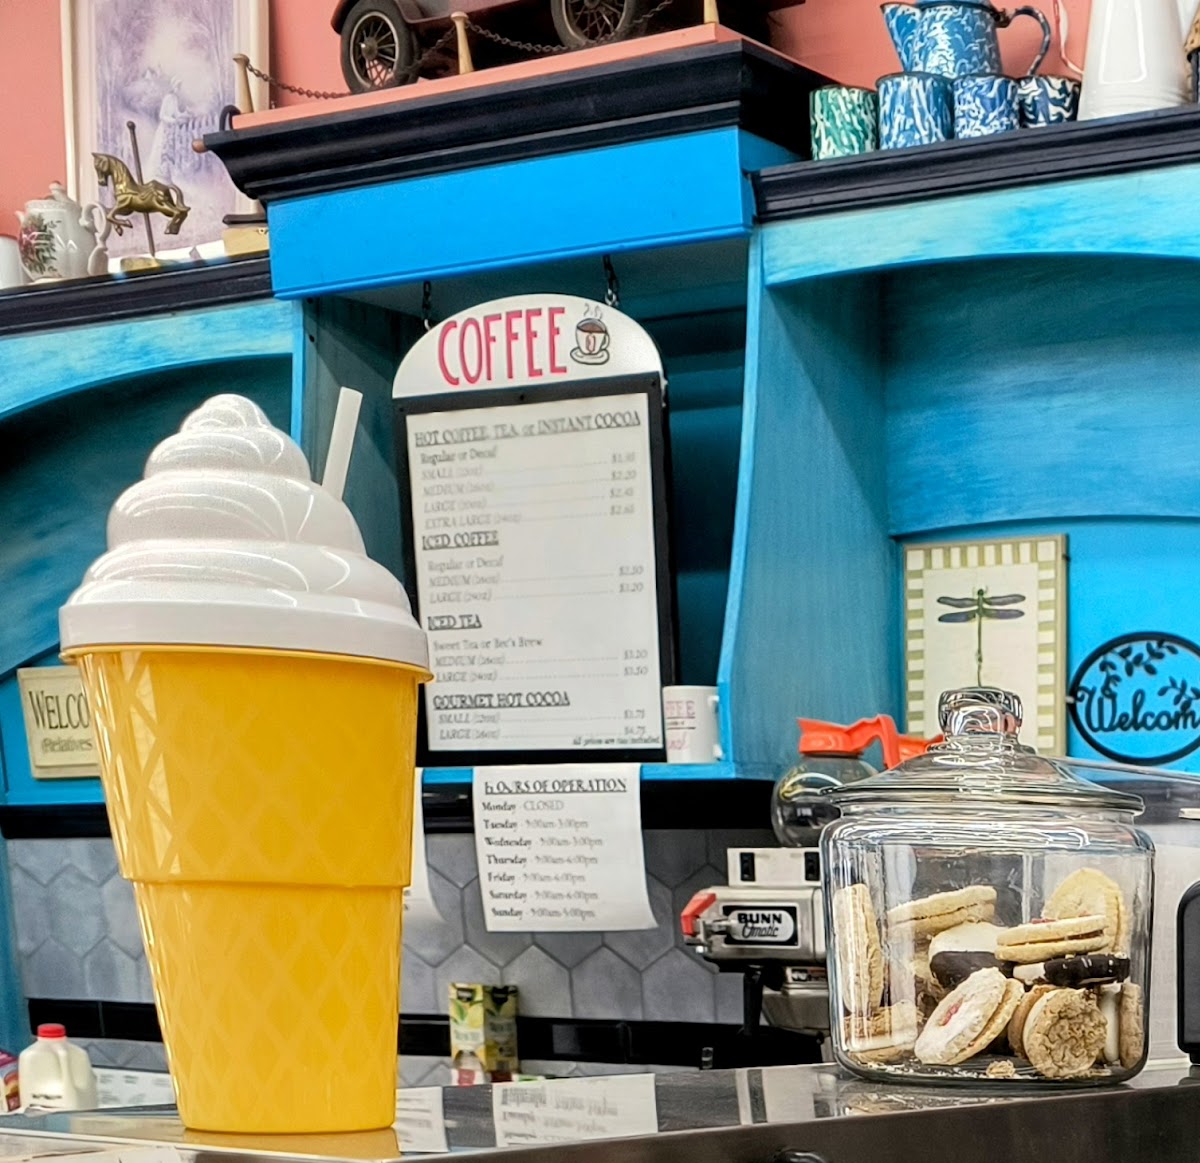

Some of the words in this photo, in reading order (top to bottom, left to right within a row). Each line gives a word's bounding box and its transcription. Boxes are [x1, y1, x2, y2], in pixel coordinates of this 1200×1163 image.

[437, 306, 568, 386] COFFEE
[414, 430, 439, 447] HOT
[594, 410, 641, 429] COCOA
[422, 533, 451, 551] ICED
[453, 529, 499, 548] COFFEE
[427, 615, 457, 631] ICED
[458, 613, 482, 630] TEA
[497, 692, 523, 708] HOT
[525, 691, 571, 707] COCOA
[551, 778, 627, 794] OPERATION
[482, 801, 516, 814] Monday
[523, 800, 564, 811] CLOSED
[483, 819, 518, 832] Tuesday
[485, 836, 532, 849] Wednesday
[487, 854, 527, 868] Thursday
[488, 872, 515, 885] Friday
[490, 890, 527, 903] Saturday
[492, 907, 523, 920] Sunday
[738, 913, 781, 924] BUNN
